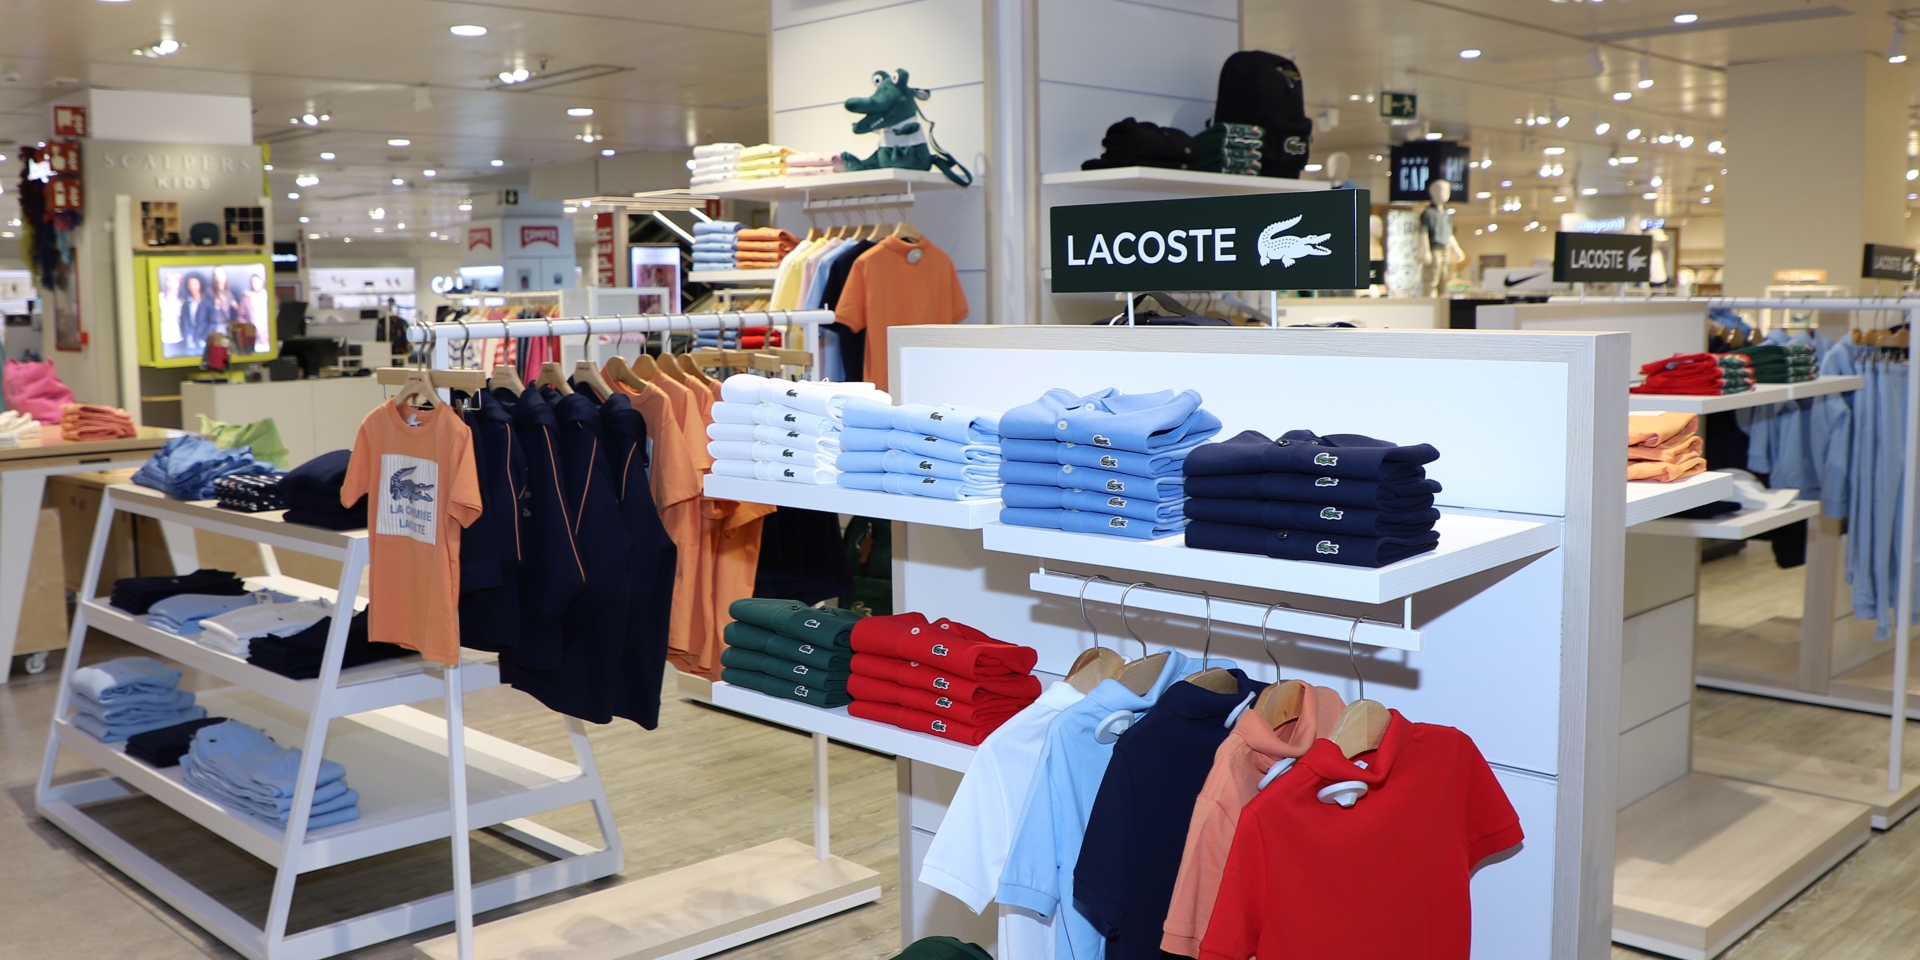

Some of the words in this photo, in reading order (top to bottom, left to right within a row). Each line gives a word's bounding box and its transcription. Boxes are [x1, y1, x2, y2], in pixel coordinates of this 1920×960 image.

[103, 152, 250, 173] SCALPERS
[155, 176, 211, 190] KIDS
[1400, 166, 1430, 191] GAP
[524, 228, 557, 242] CAMPER
[1067, 227, 1236, 266] LACOSTE
[1571, 249, 1624, 269] LACOSTE
[390, 504, 404, 514] LA
